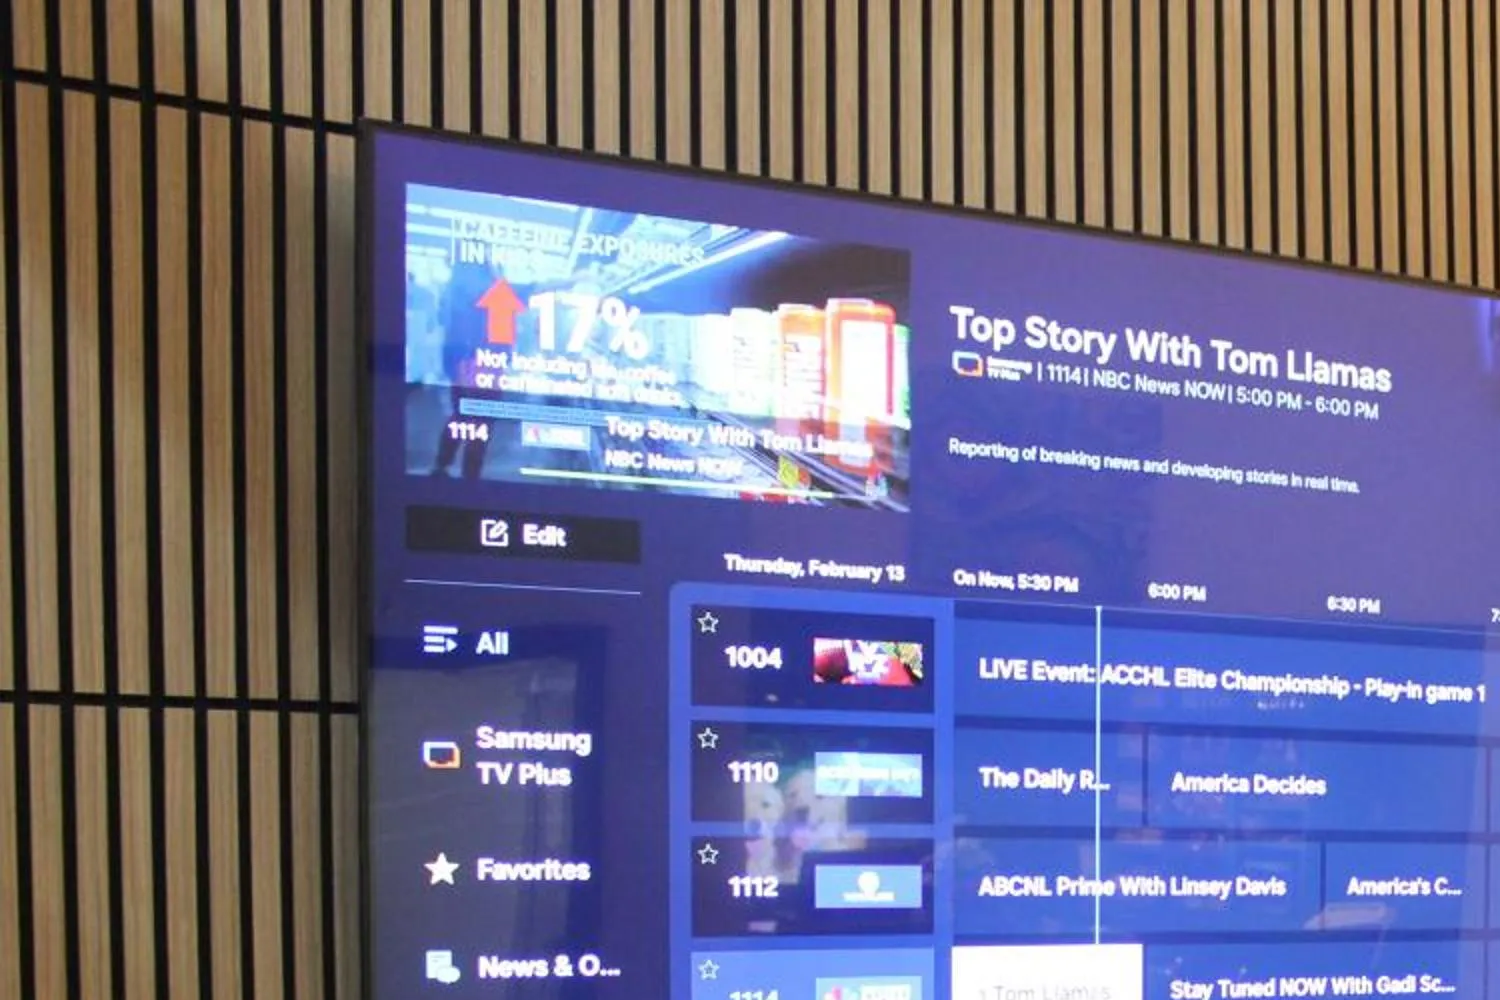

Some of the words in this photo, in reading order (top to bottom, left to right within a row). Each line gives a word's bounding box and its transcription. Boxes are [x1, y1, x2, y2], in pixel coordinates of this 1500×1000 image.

[460, 238, 486, 265] IN
[527, 291, 650, 361] 17%
[475, 348, 507, 370] Not
[948, 305, 1016, 352] Top
[1023, 314, 1118, 366] Story
[1125, 327, 1202, 370] With
[1210, 338, 1280, 380] Tom
[1285, 349, 1394, 394] Llamas
[474, 373, 497, 389] or
[1047, 363, 1082, 386] 1114
[1093, 370, 1131, 391] NBC
[1135, 375, 1181, 399] News
[1184, 379, 1226, 402] NOW
[1236, 385, 1273, 408] 5:00
[1276, 390, 1303, 412] PM
[1315, 395, 1351, 417] 6:00
[1354, 400, 1380, 421] PM
[447, 420, 489, 443] 1114
[605, 416, 644, 447] Top
[647, 421, 702, 450] Story
[708, 425, 757, 451] With
[759, 430, 802, 454] Tom
[604, 449, 643, 471] NBC
[948, 438, 1019, 463] Reporting
[1022, 445, 1037, 462] of
[1040, 446, 1101, 471] breaking
[1103, 455, 1141, 473] news
[1143, 457, 1170, 476] and
[1171, 458, 1244, 486] developing
[1246, 466, 1289, 487] stories
[1291, 471, 1303, 488] in
[1304, 472, 1329, 491] real
[522, 523, 567, 548] Edit
[723, 552, 806, 578] Thursday,
[808, 558, 883, 583] February
[885, 563, 907, 583] 13
[953, 568, 975, 589] On
[1017, 572, 1052, 592] 5:30
[1053, 575, 1080, 594] PM
[1147, 582, 1181, 601] 6:00
[1183, 585, 1207, 603] PM
[1355, 597, 1381, 616] PM
[475, 630, 510, 657] All
[724, 645, 784, 671] 1004
[979, 657, 1029, 682] LIVE
[1031, 660, 1097, 685] Event:
[1100, 663, 1171, 688] ACCHL
[1174, 666, 1219, 691] Elite
[1221, 669, 1351, 700] Championship
[1426, 682, 1474, 706] game
[1476, 683, 1488, 704] 1
[475, 725, 592, 757] Samsung
[476, 762, 515, 786] TV
[518, 762, 573, 788] Plus
[728, 760, 780, 785] 1110
[979, 766, 1020, 790] The
[1022, 767, 1076, 794] Daily
[1170, 771, 1251, 795] America
[1253, 773, 1327, 797] Decides
[476, 856, 592, 883] Favorites
[728, 874, 780, 899] 1112
[978, 875, 1053, 898] ABCNL
[1056, 875, 1116, 898] Prime
[1118, 875, 1167, 898] With
[1169, 874, 1233, 903] Linsey
[1235, 875, 1288, 898] Davis
[1346, 875, 1432, 897] America's
[478, 955, 549, 979] News
[552, 955, 574, 979] &
[1216, 977, 1277, 1000] Tuned
[1279, 977, 1329, 999] NOW
[1330, 975, 1374, 998] With
